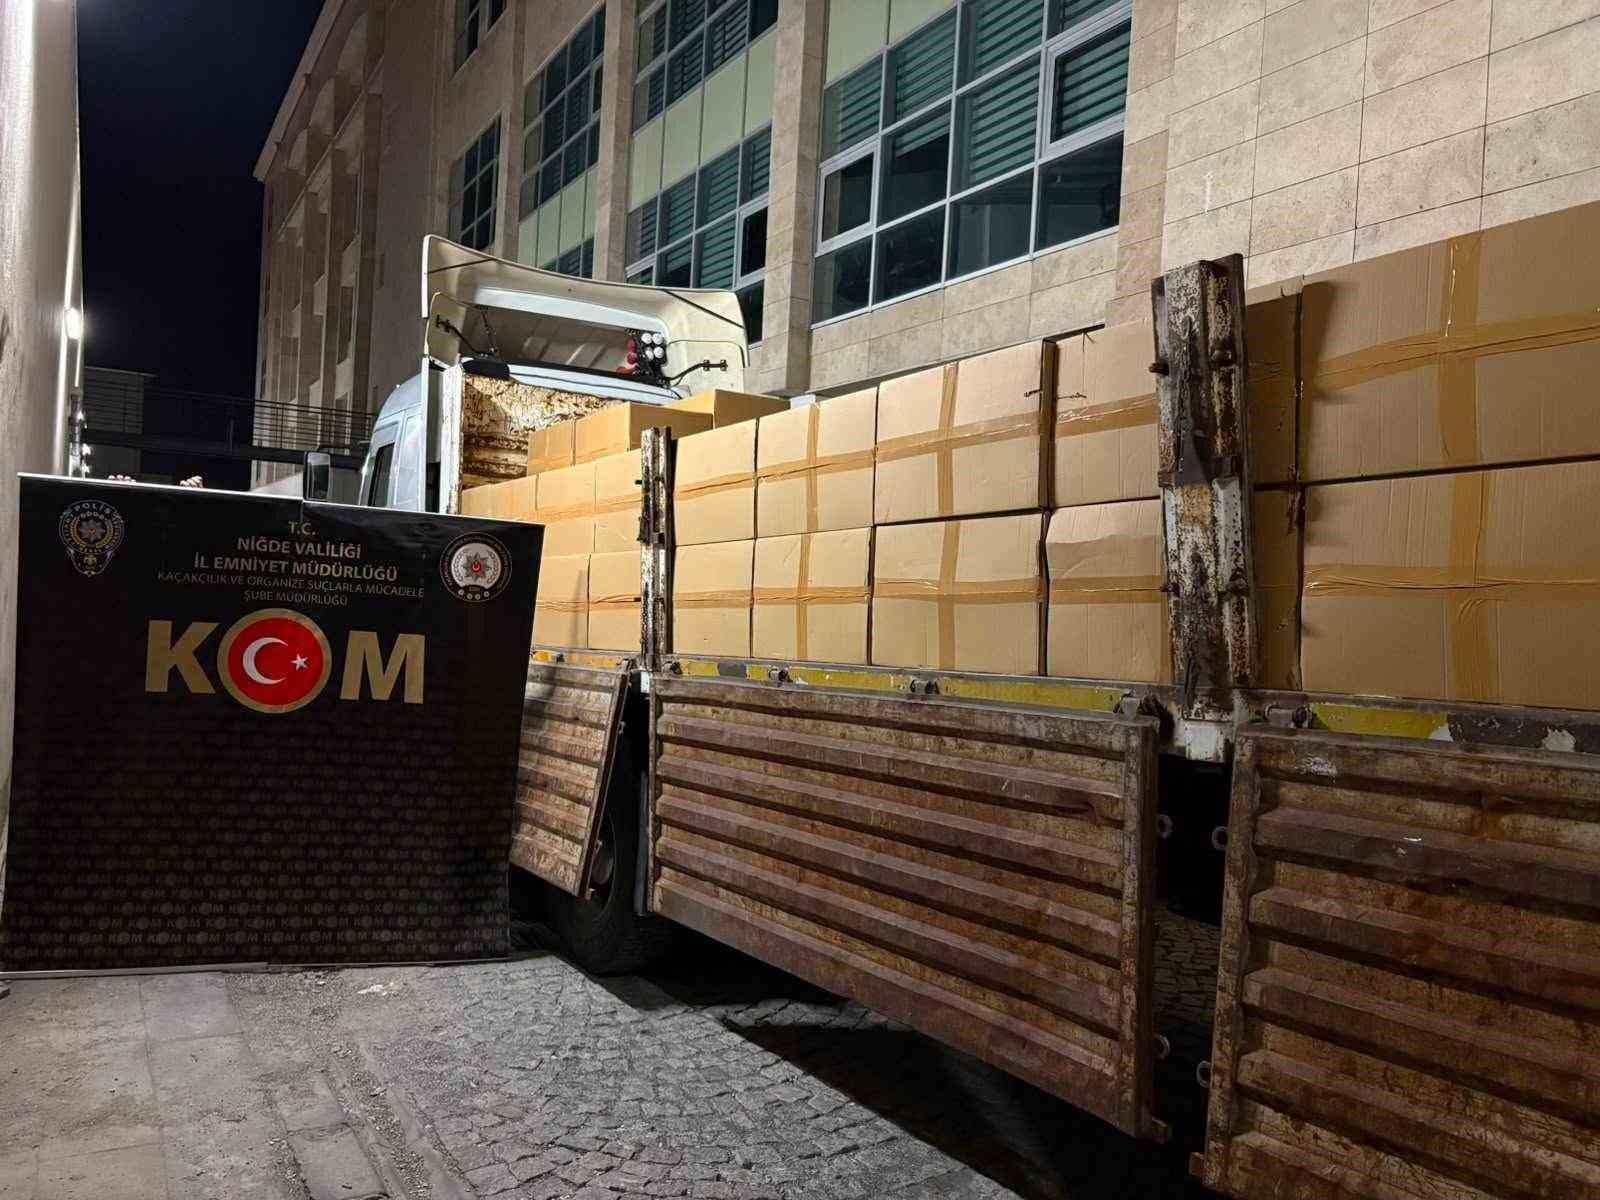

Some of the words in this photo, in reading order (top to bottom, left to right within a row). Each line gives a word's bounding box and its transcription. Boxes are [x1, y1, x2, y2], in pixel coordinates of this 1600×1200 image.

[288, 520, 316, 535] T.C.
[237, 535, 291, 554] NİĞDE
[294, 540, 362, 559] VALİLİĞİ
[194, 551, 209, 569] İL
[213, 556, 288, 574] EMNİYET
[291, 560, 398, 581] MÜDÜRLÜĞÜ
[157, 570, 228, 585] KAÇAKÇILIK
[230, 575, 243, 585] VE
[307, 580, 364, 593] SUÇLARLA
[365, 583, 424, 598] MÜCADELE
[243, 589, 273, 602] ŞUBE
[145, 608, 425, 714] KOM
